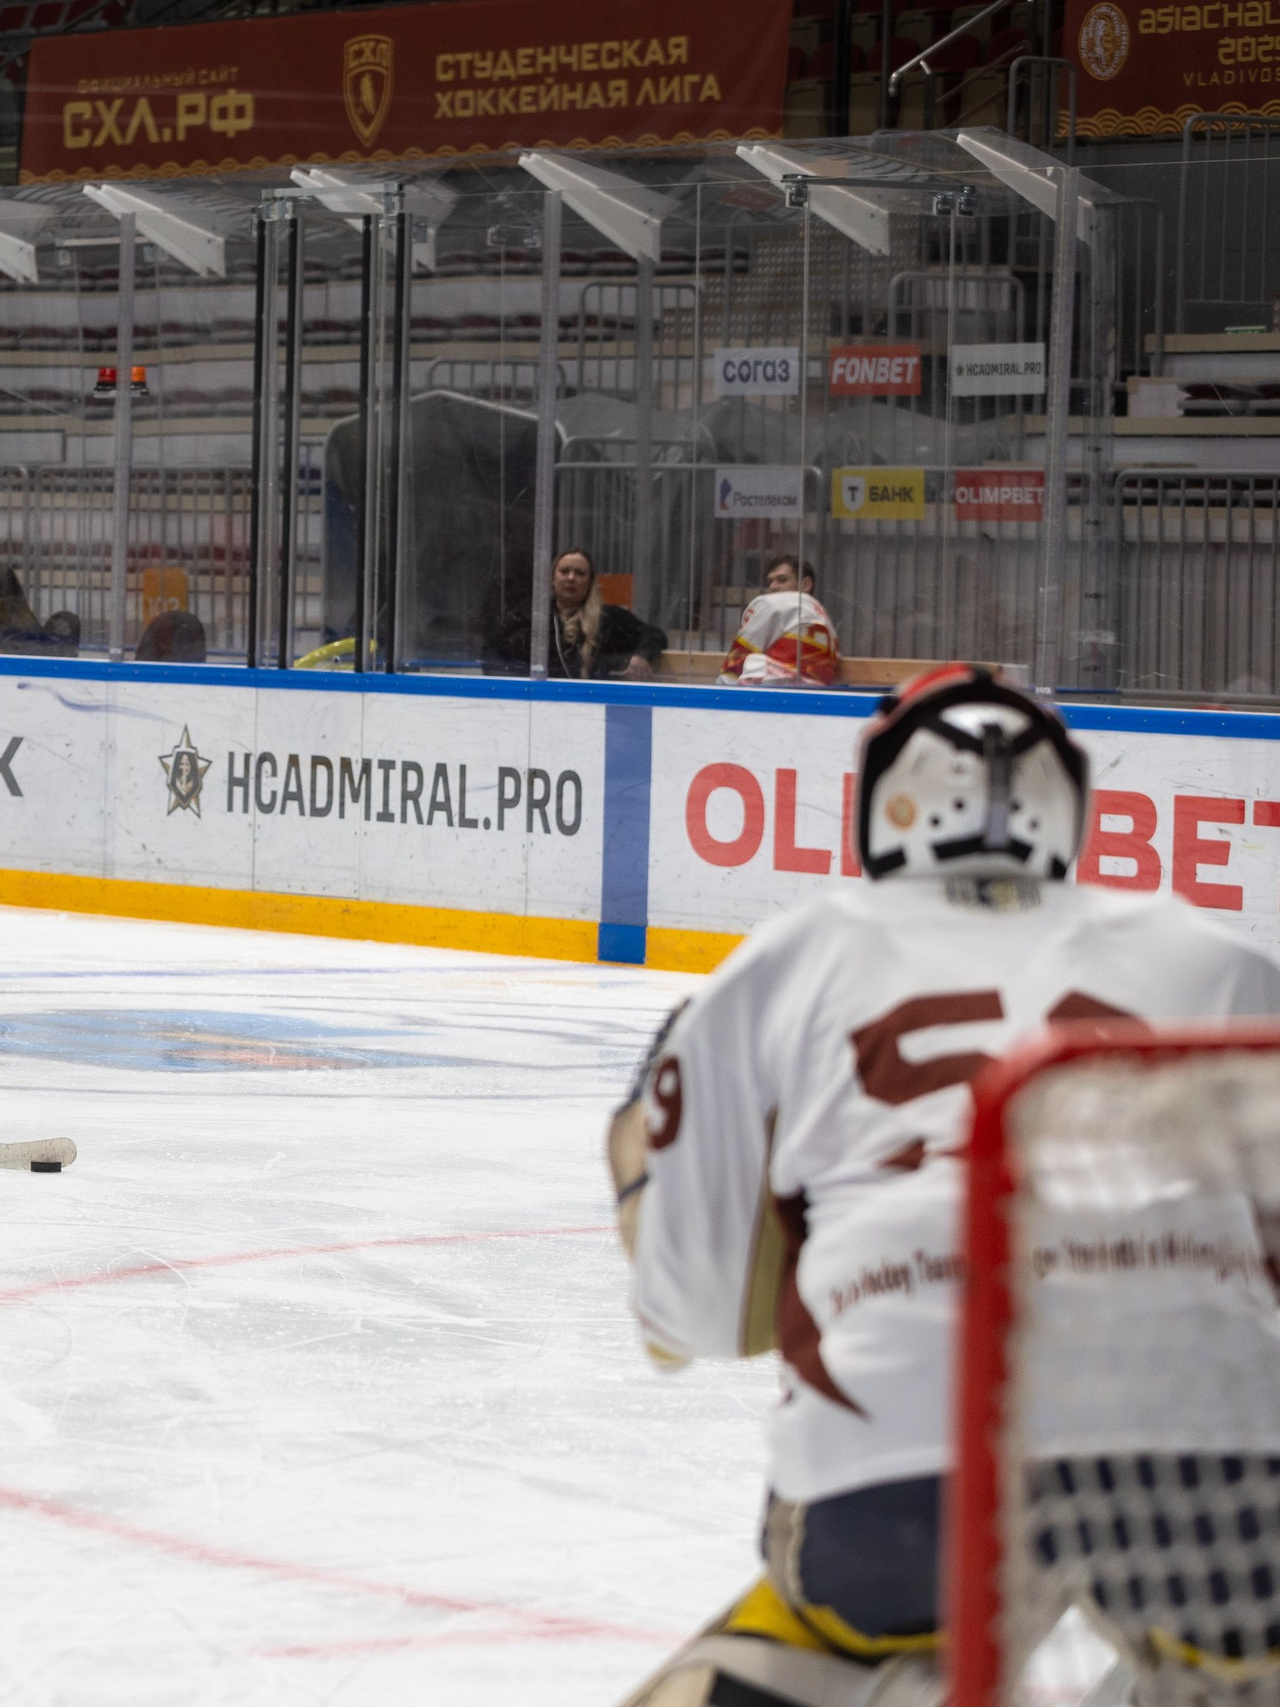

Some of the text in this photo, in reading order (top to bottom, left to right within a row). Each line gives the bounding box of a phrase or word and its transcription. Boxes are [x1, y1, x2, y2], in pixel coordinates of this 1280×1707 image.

[435, 36, 689, 82] СТУДЕНЧЕСКАЯ
[1218, 35, 1280, 65] 202
[434, 74, 721, 119] ХОККЕЙНАЯ ЛИГА
[63, 88, 256, 149] СХЛ.РФ
[831, 356, 919, 385] FONBET
[966, 363, 1042, 378] HCADMIRAL.PRO
[870, 486, 914, 503] БАНК
[955, 486, 1045, 506] OLIMPBET
[227, 751, 583, 837] HCADMIRAL.PRO
